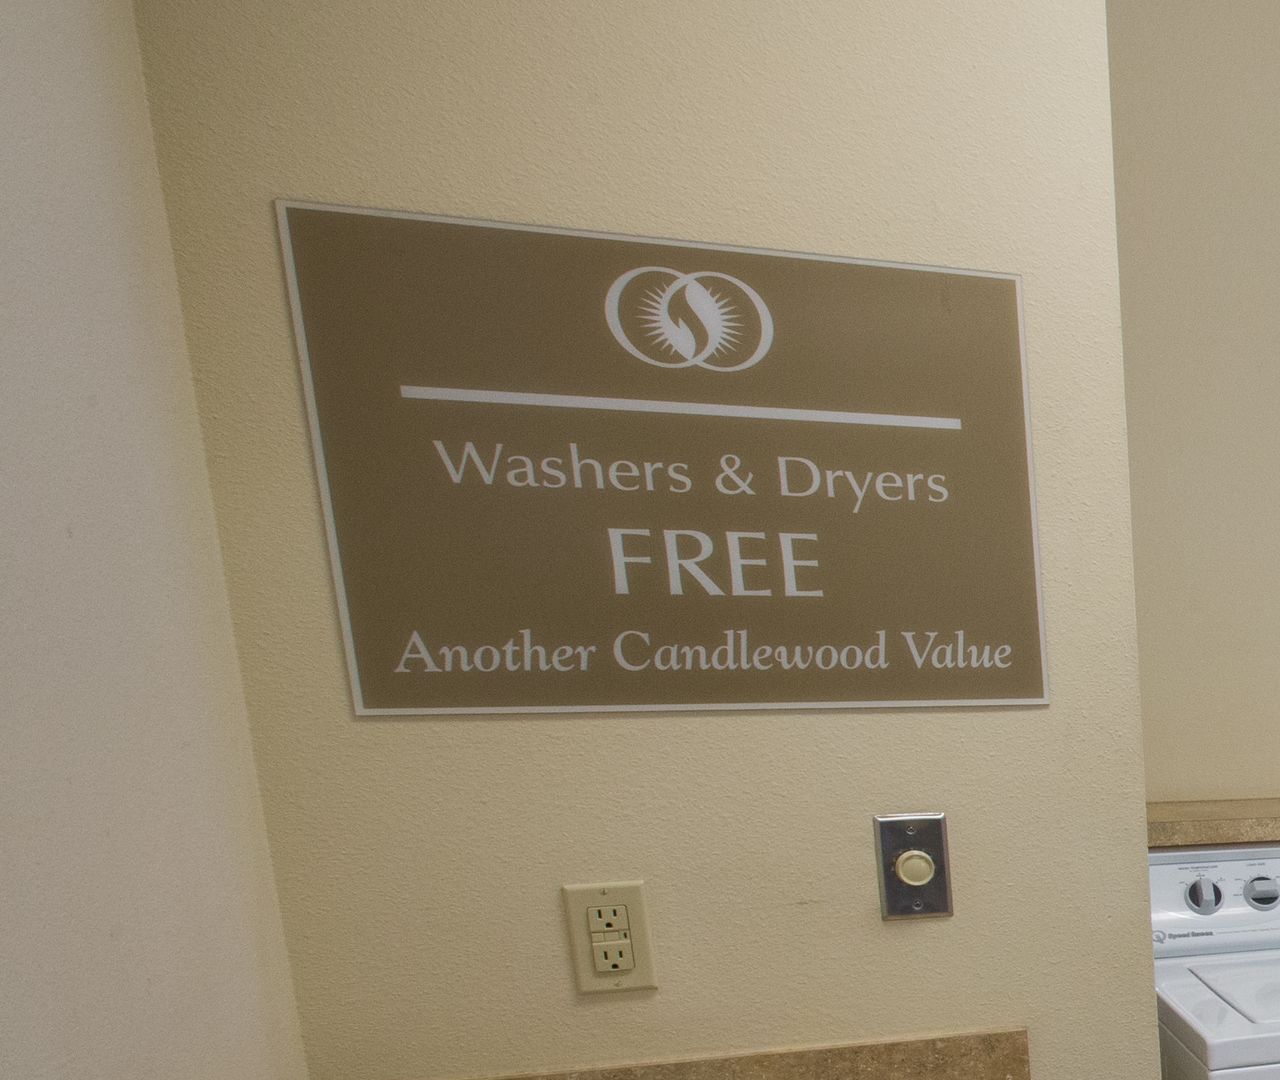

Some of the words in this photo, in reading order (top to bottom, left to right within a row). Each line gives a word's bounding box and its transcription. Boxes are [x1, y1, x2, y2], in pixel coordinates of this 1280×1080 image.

[432, 439, 693, 494] Washers
[714, 453, 756, 496] &
[777, 455, 950, 514] Dryers
[606, 527, 825, 598] FREE
[393, 628, 597, 674] Another
[613, 628, 890, 673] Candlewood
[901, 629, 1013, 670] Value
